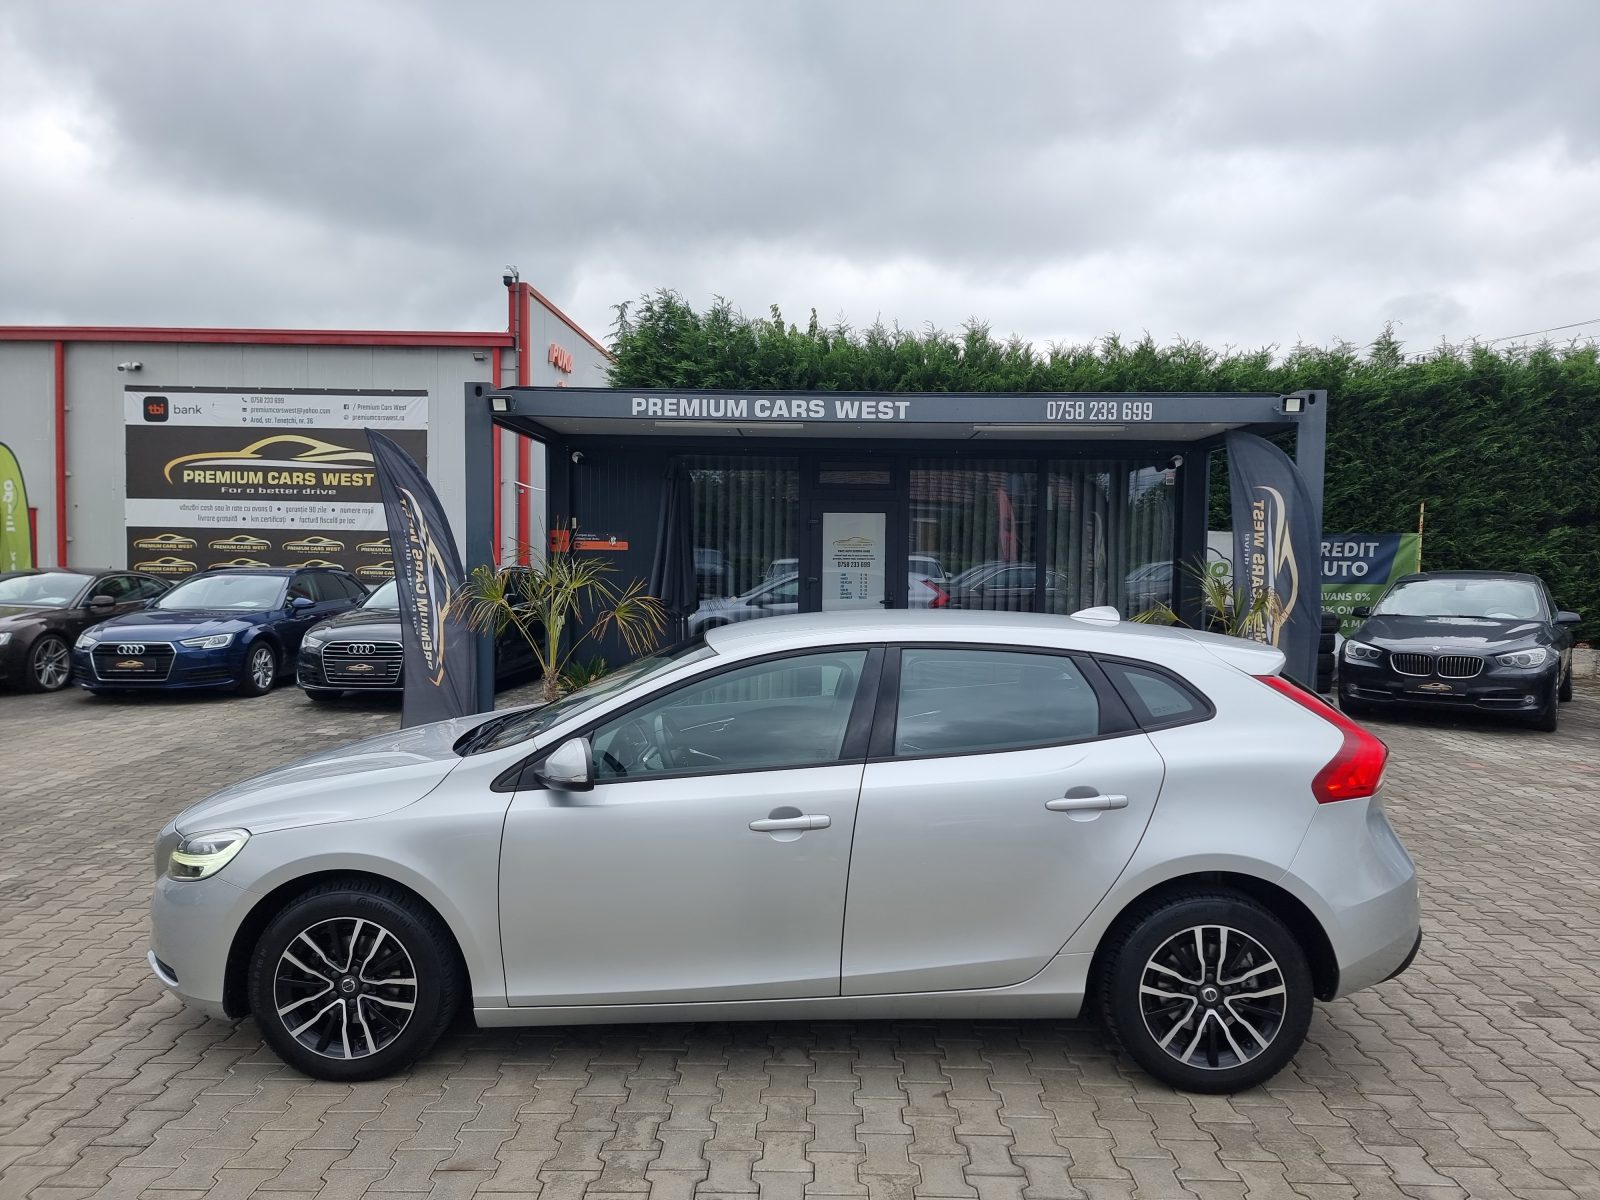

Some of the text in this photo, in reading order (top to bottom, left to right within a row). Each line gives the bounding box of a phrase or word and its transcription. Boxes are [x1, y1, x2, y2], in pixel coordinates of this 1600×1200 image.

[148, 403, 202, 415] tbi bank
[357, 403, 380, 411] Premium
[632, 397, 910, 420] PREMIUM CARS WEST
[1046, 401, 1153, 421] 0758 233 699
[183, 470, 374, 487] PREMIUM CARS WEST
[221, 486, 243, 494] For
[258, 487, 300, 495] better
[302, 487, 337, 495] drive
[1320, 541, 1380, 558] REDIT
[1320, 560, 1369, 577] UTO
[1354, 592, 1371, 601] 0%
